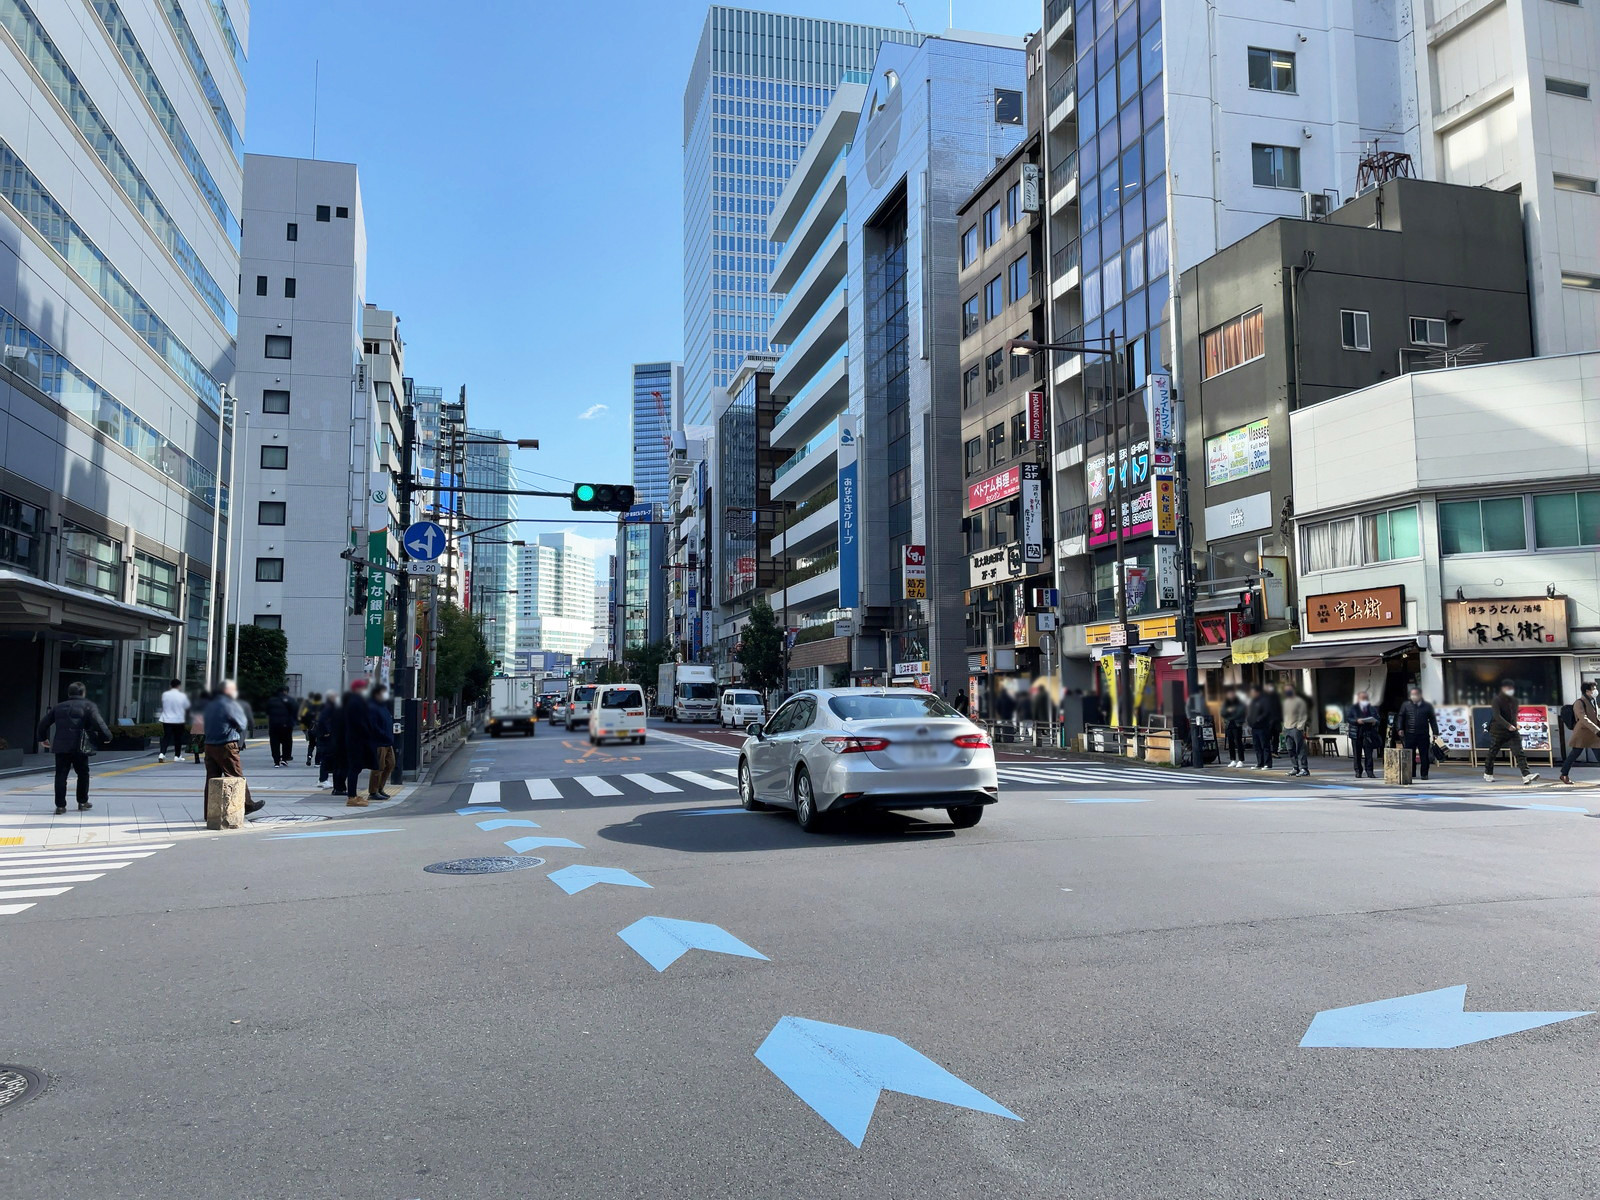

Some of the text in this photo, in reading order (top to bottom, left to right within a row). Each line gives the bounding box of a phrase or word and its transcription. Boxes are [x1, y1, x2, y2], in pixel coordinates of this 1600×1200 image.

[1024, 464, 1039, 472] 2F
[973, 472, 1010, 497] ベトナム料理
[843, 477, 854, 545] あなぶきグループ
[906, 546, 925, 565] くすり
[369, 557, 383, 625] りそな銀行
[907, 579, 925, 588] 処方
[907, 589, 925, 598] せん
